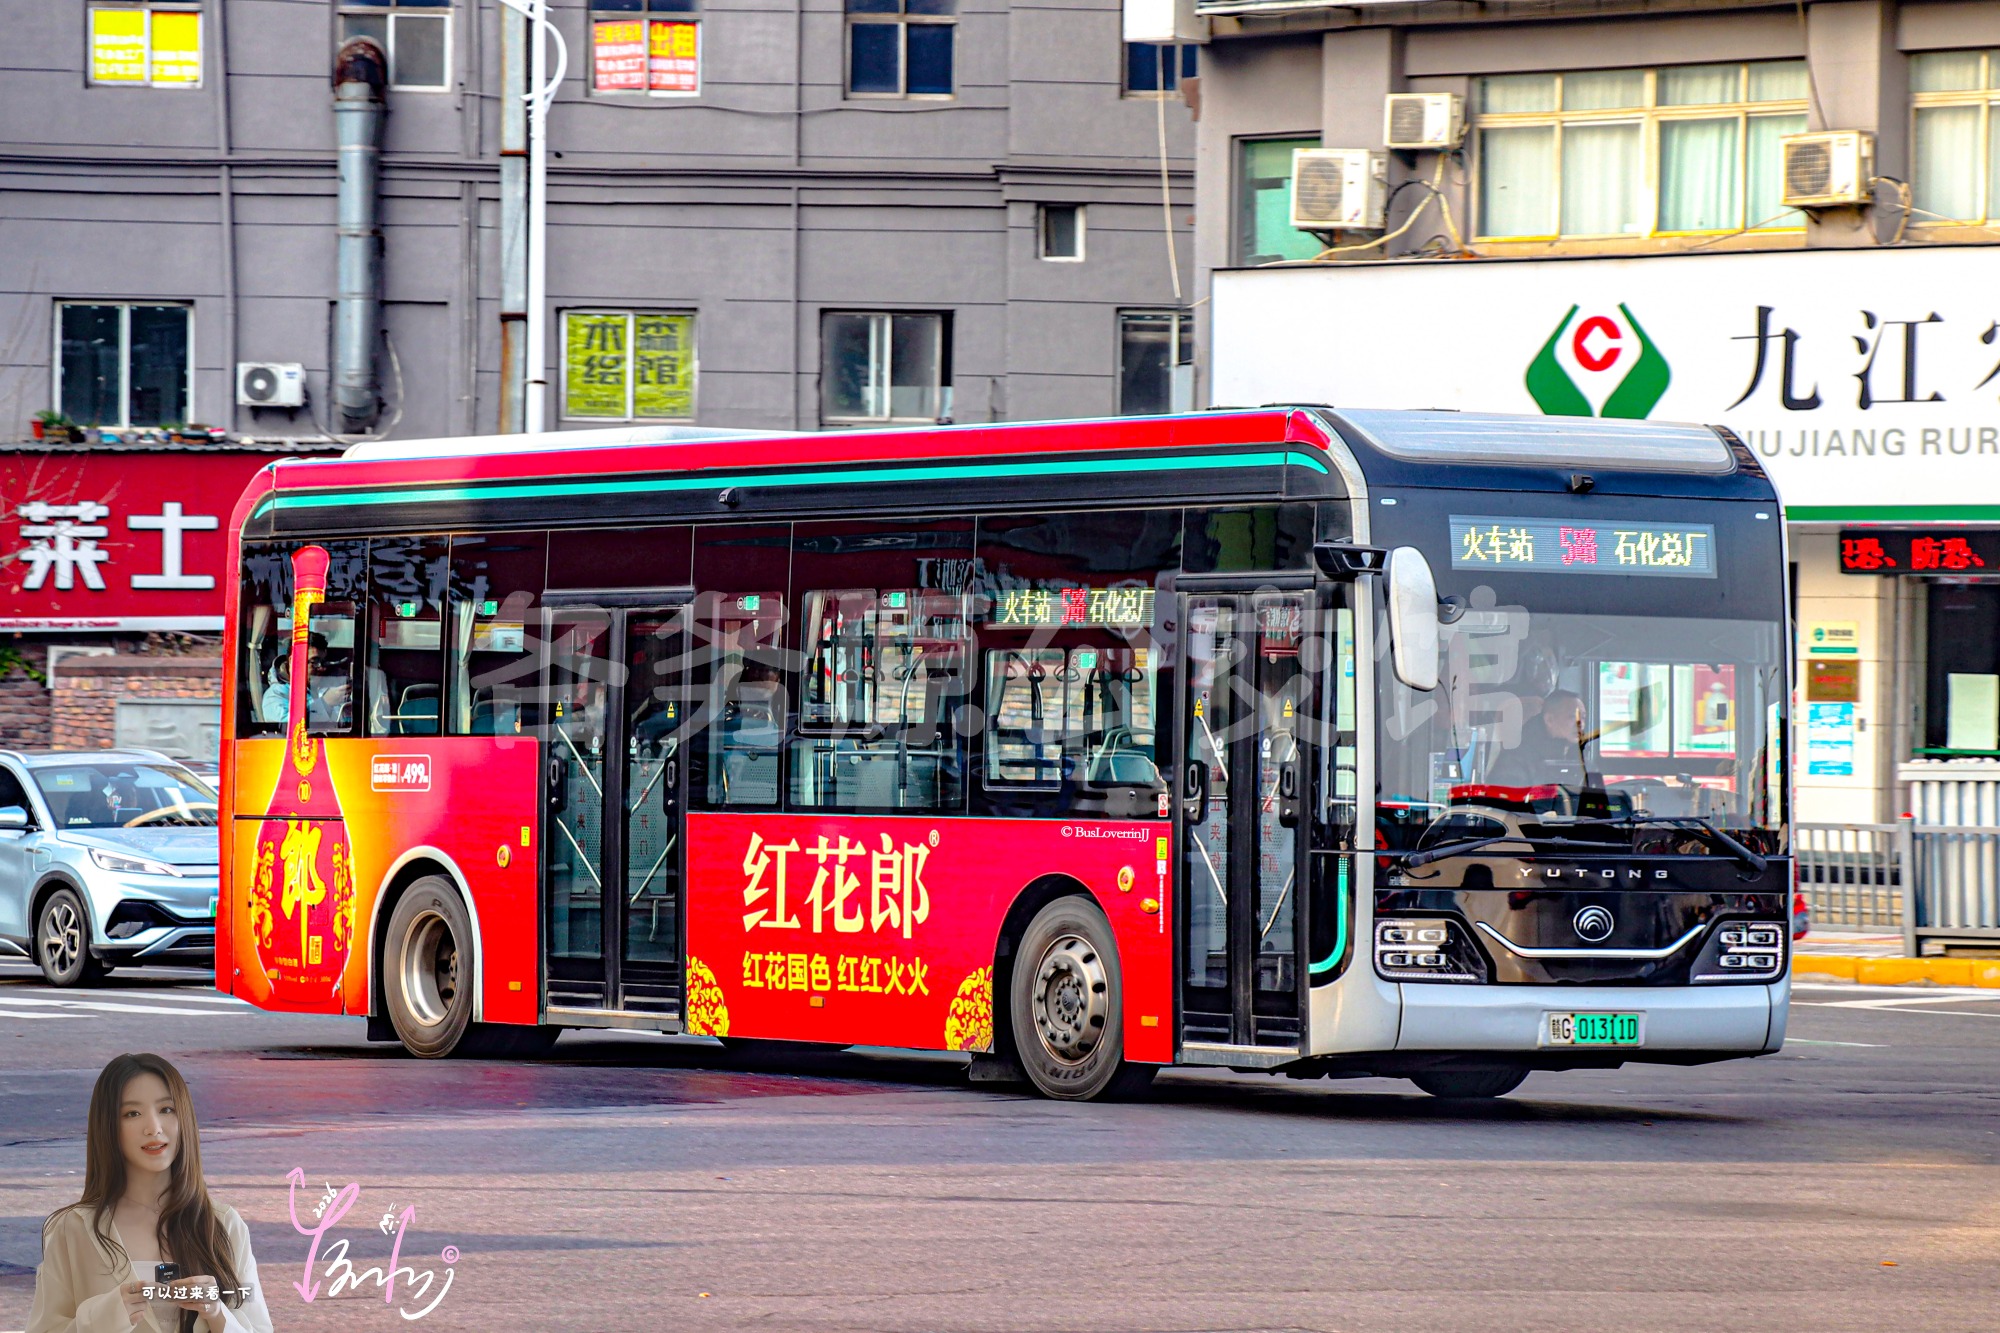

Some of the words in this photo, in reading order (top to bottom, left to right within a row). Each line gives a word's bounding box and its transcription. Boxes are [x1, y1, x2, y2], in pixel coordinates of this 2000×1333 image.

[18, 501, 219, 590] 莱士
[1461, 525, 1535, 563] 火车站
[1613, 531, 1708, 567] 石化总厂
[1002, 589, 1052, 625] 火车站
[1089, 589, 1156, 624] 石化总厂
[743, 831, 930, 939] 红花郎
[1520, 868, 1668, 879] YUTONG
[742, 951, 831, 992] 红花国色
[837, 954, 929, 996] 红红火火
